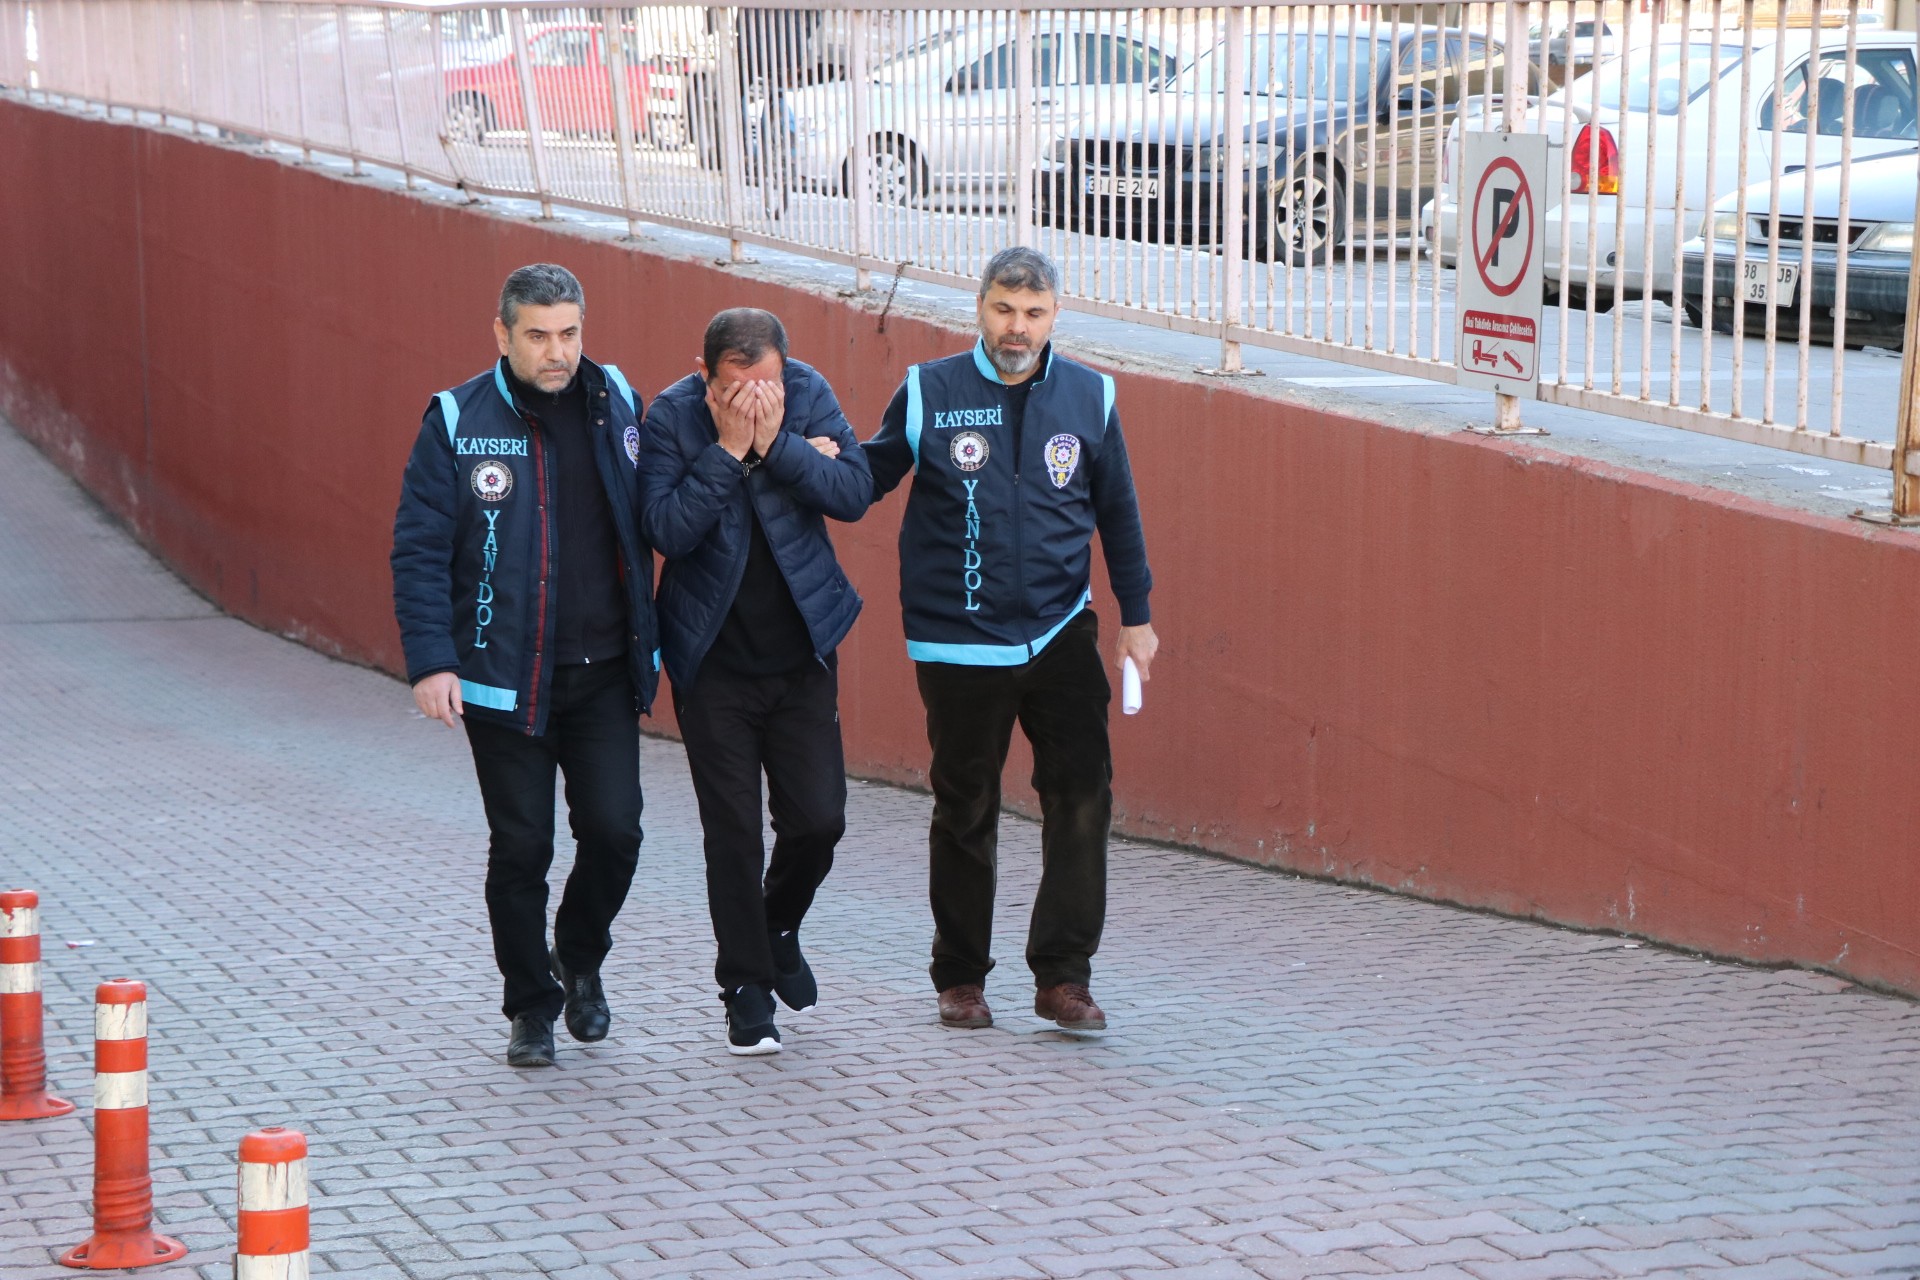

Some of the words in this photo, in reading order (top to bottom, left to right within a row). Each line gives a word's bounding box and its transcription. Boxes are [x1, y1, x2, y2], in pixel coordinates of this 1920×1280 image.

[1132, 181, 1156, 196] 24
[1491, 188, 1519, 267] P
[934, 404, 1003, 429] KAYSERİ
[456, 435, 528, 457] KAYSERİ
